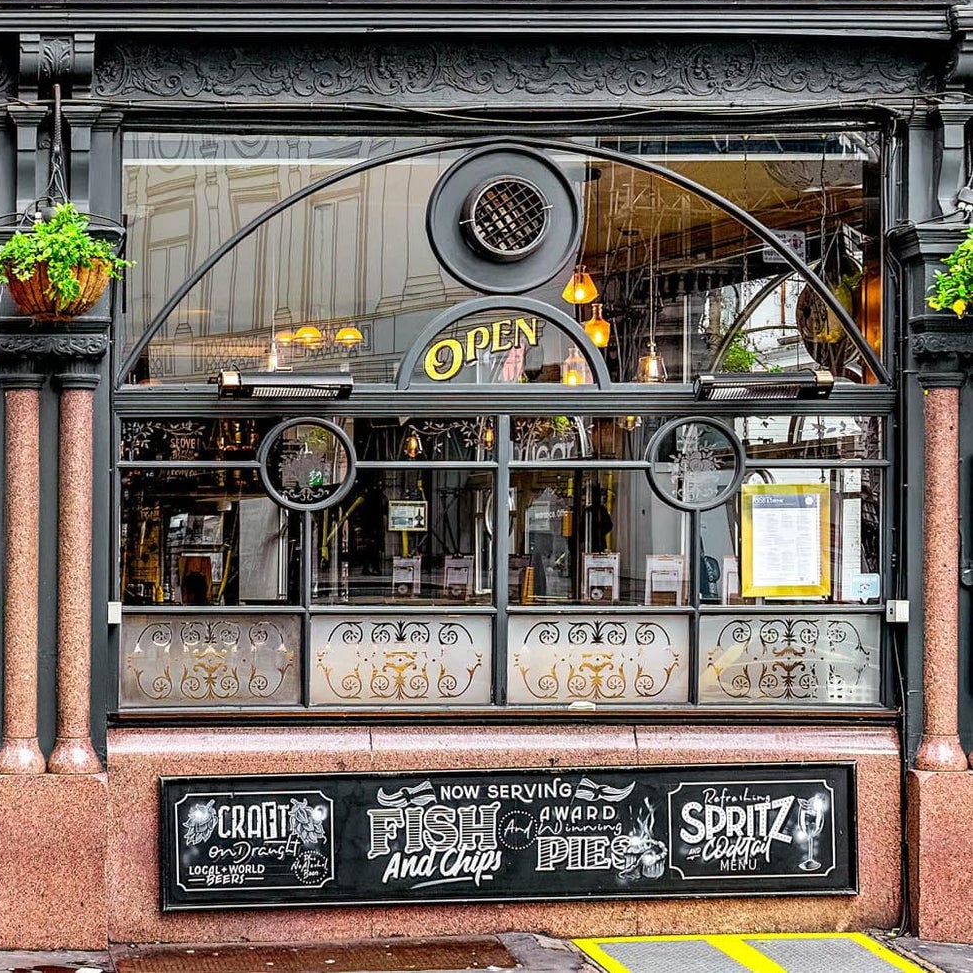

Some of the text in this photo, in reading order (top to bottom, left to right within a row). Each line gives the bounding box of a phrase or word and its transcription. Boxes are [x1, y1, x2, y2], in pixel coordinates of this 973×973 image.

[423, 317, 538, 381] OPEN
[440, 777, 572, 803] NOW SERVING
[218, 801, 290, 840] CRAFT
[367, 801, 501, 860] FISH
[540, 805, 616, 824] AWARD
[679, 795, 795, 845] SPRITZ
[188, 865, 221, 876] LOCAL
[228, 864, 266, 874] WORLD
[382, 843, 502, 887] And Chips
[535, 835, 633, 872] PIES
[720, 858, 757, 871] MENU
[206, 874, 245, 886] BEERS
